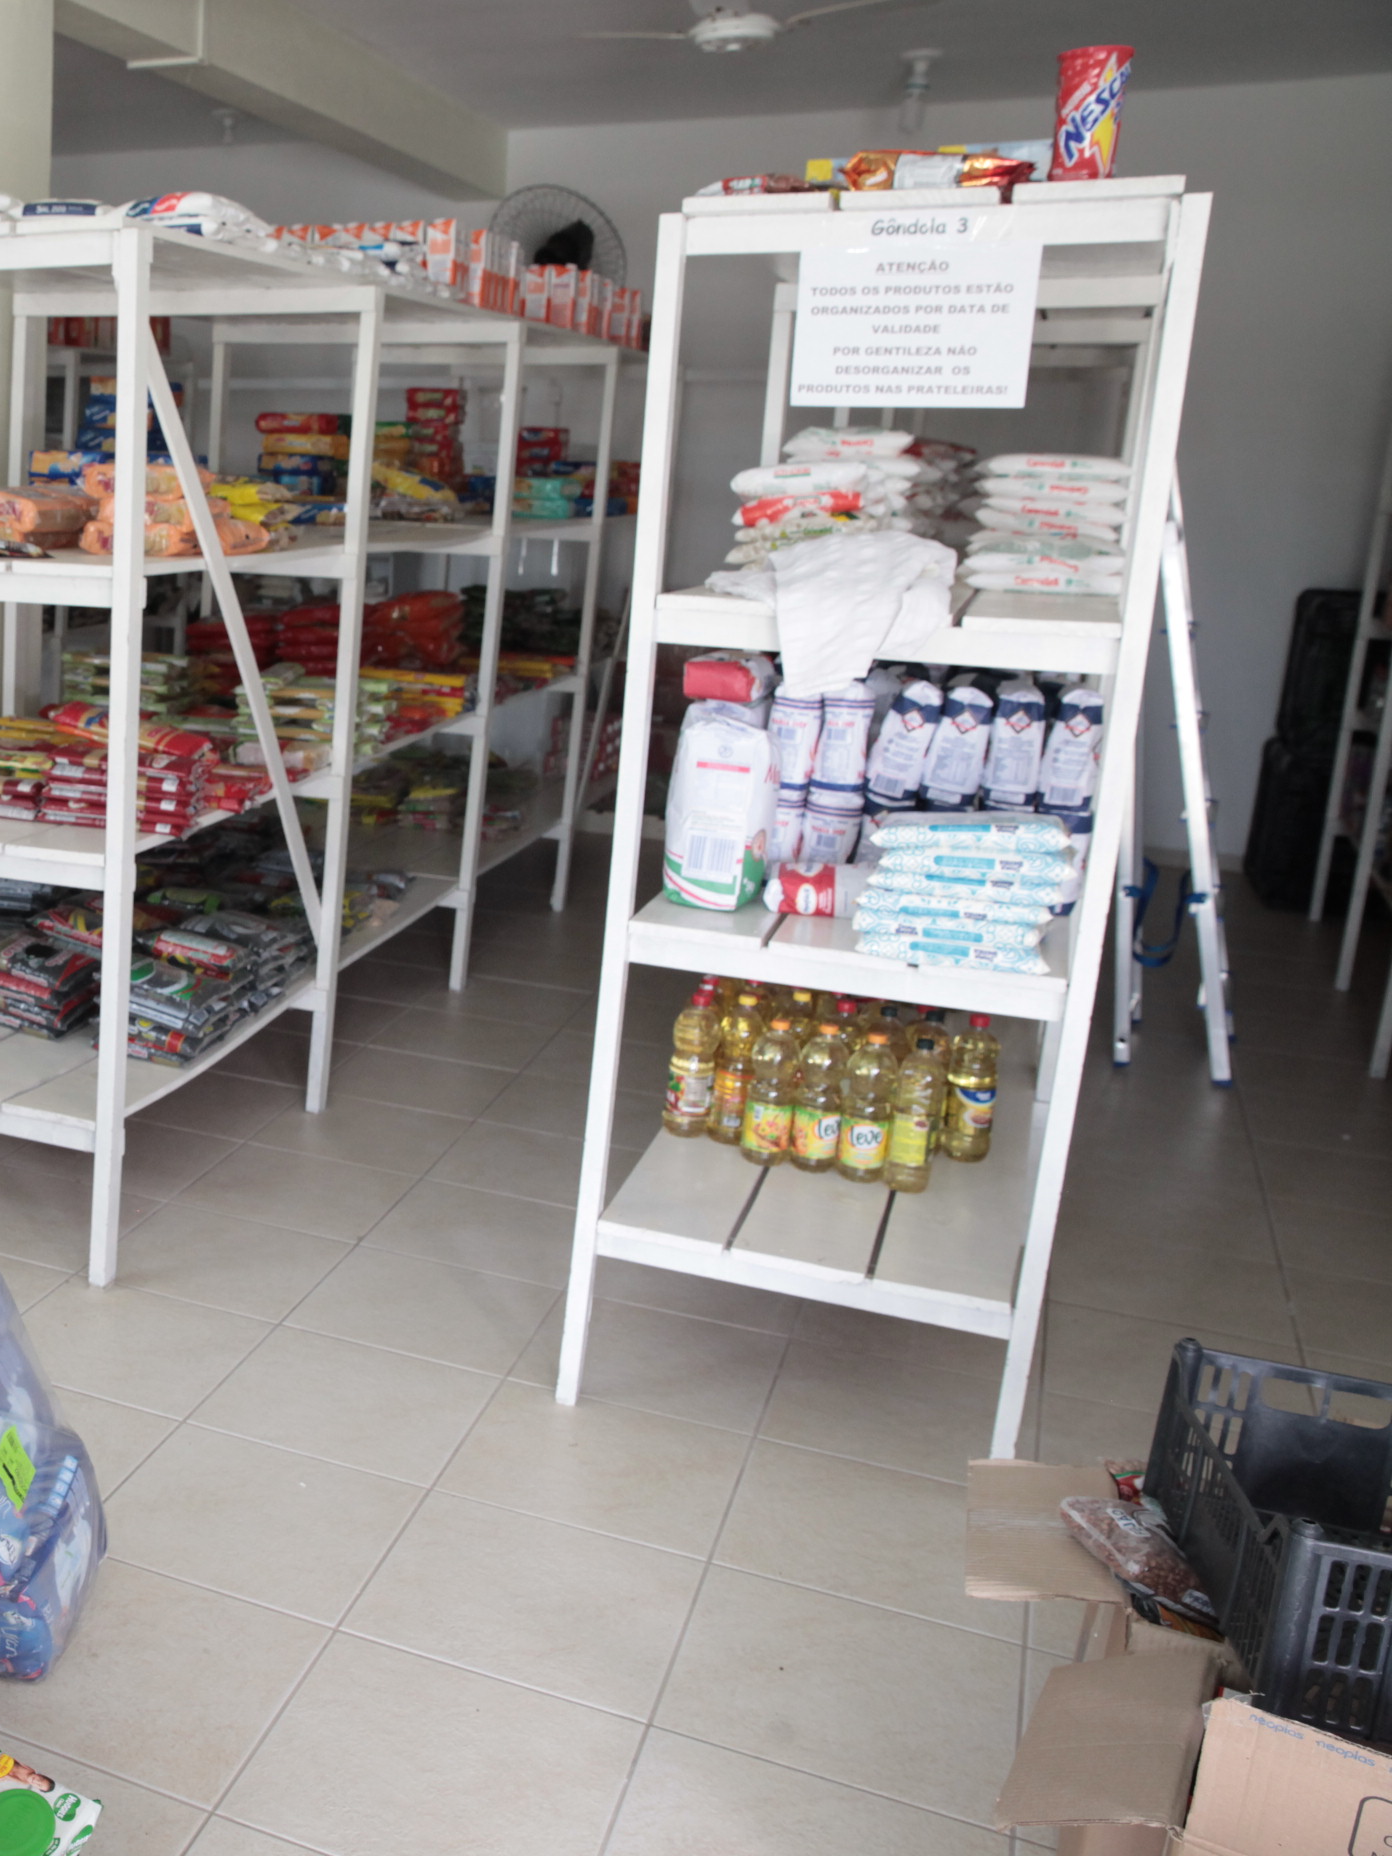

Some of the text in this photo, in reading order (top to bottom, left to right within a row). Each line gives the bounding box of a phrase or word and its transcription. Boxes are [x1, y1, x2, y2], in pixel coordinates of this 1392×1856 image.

[871, 218, 969, 236] Gôndola 3
[875, 261, 949, 275] ATENÇÃO
[811, 283, 1014, 297] TODOS OS PRODUTOS ESTÃO
[811, 304, 1010, 316] ORGANIZADOS POR DATA DE
[872, 325, 941, 335] VALIDADE
[833, 345, 977, 356] POR GENTILEZA NÃO
[835, 365, 970, 375] DESORGANIZAR OS
[798, 384, 1008, 395] PRODUTOS NAS PRATELEIRAS!
[1249, 1714, 1305, 1740] neoplas
[1316, 1740, 1376, 1767] neoplas
